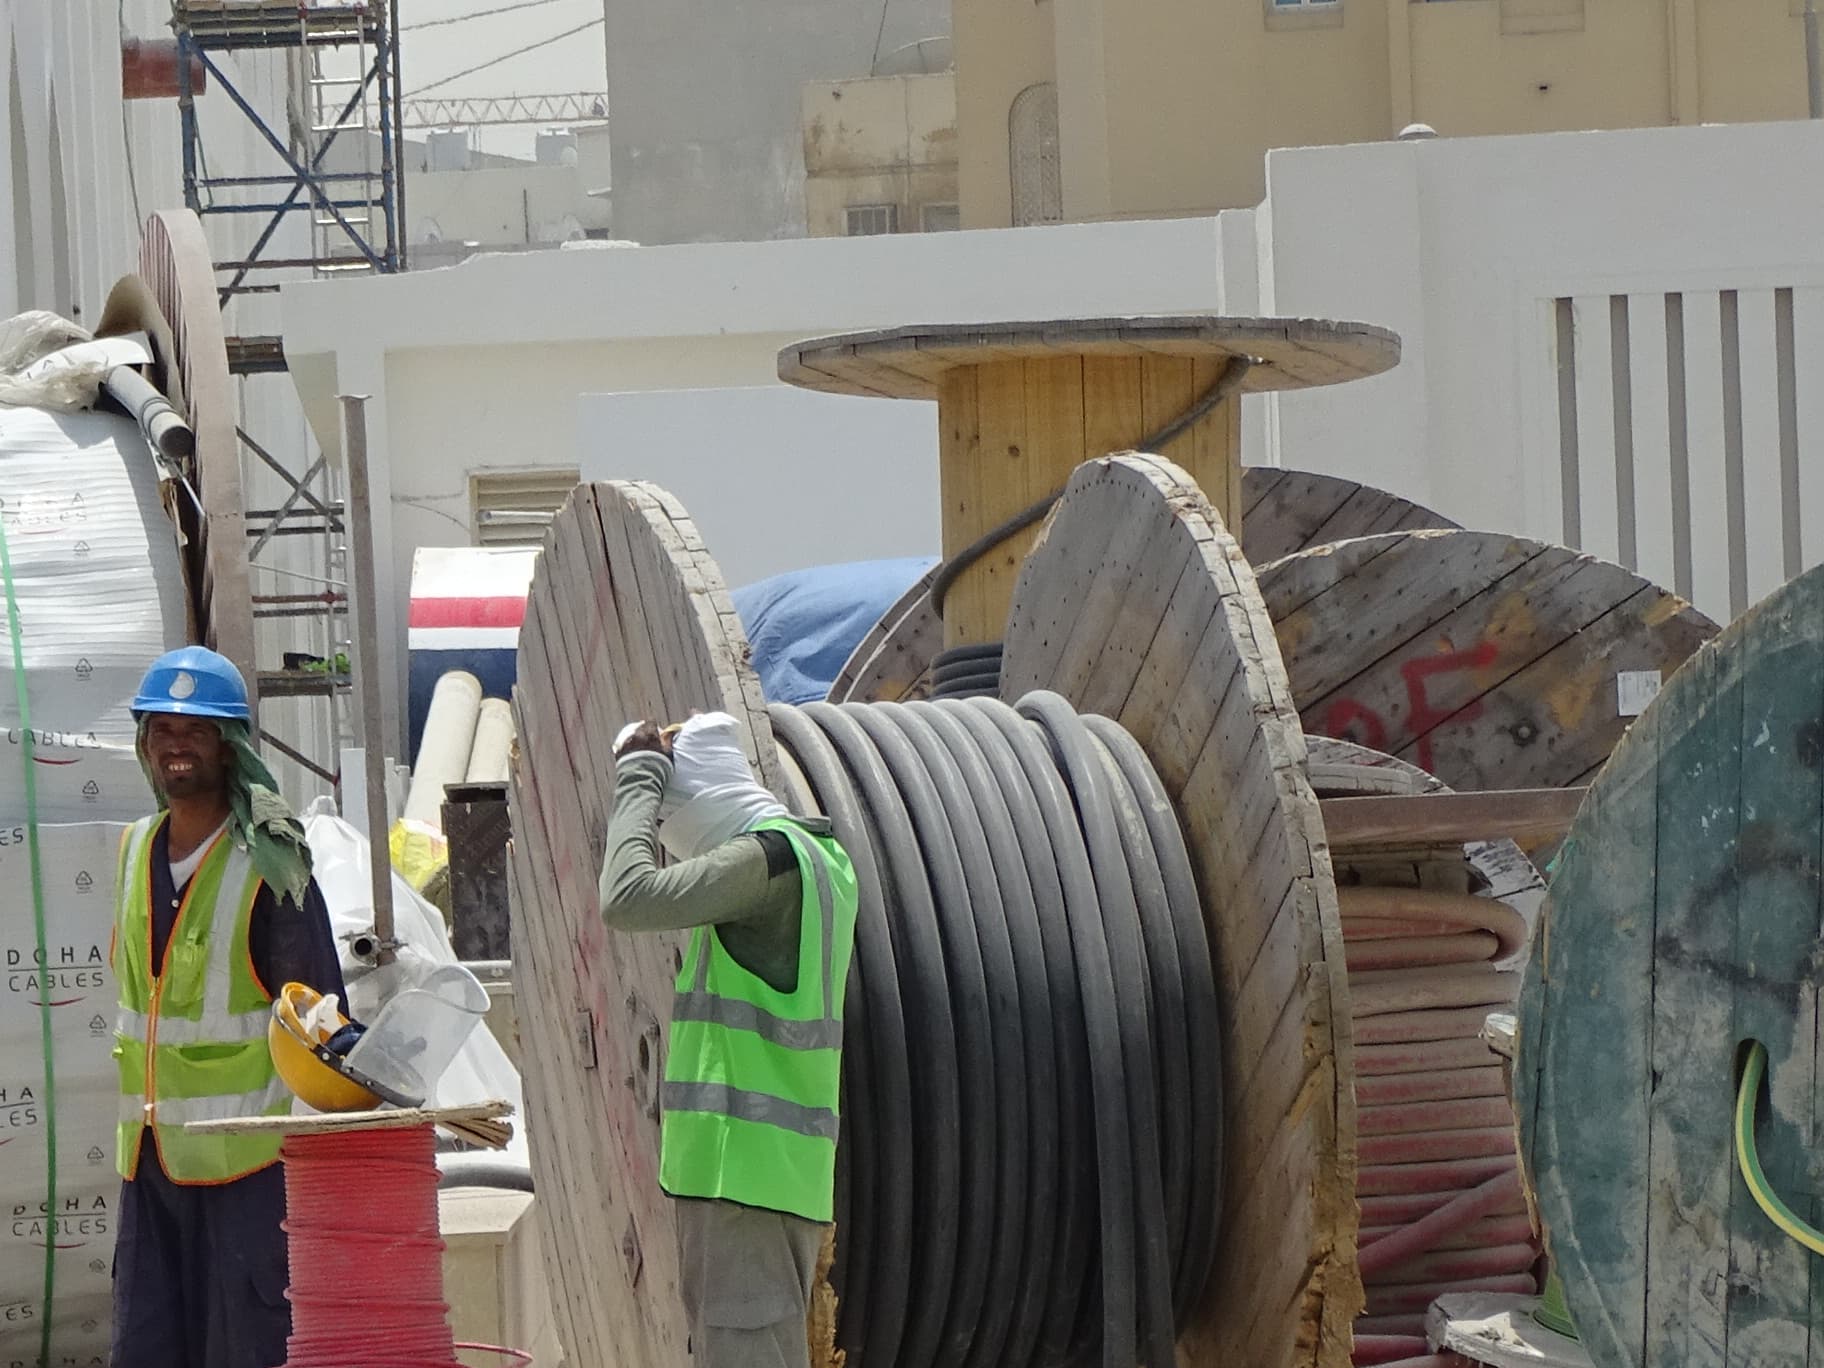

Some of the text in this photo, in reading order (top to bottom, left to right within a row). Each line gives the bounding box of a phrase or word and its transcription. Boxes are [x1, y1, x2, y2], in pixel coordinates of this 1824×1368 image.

[7, 945, 102, 966] DOHA
[9, 972, 104, 992] CABLES
[13, 1195, 106, 1215] DOHA
